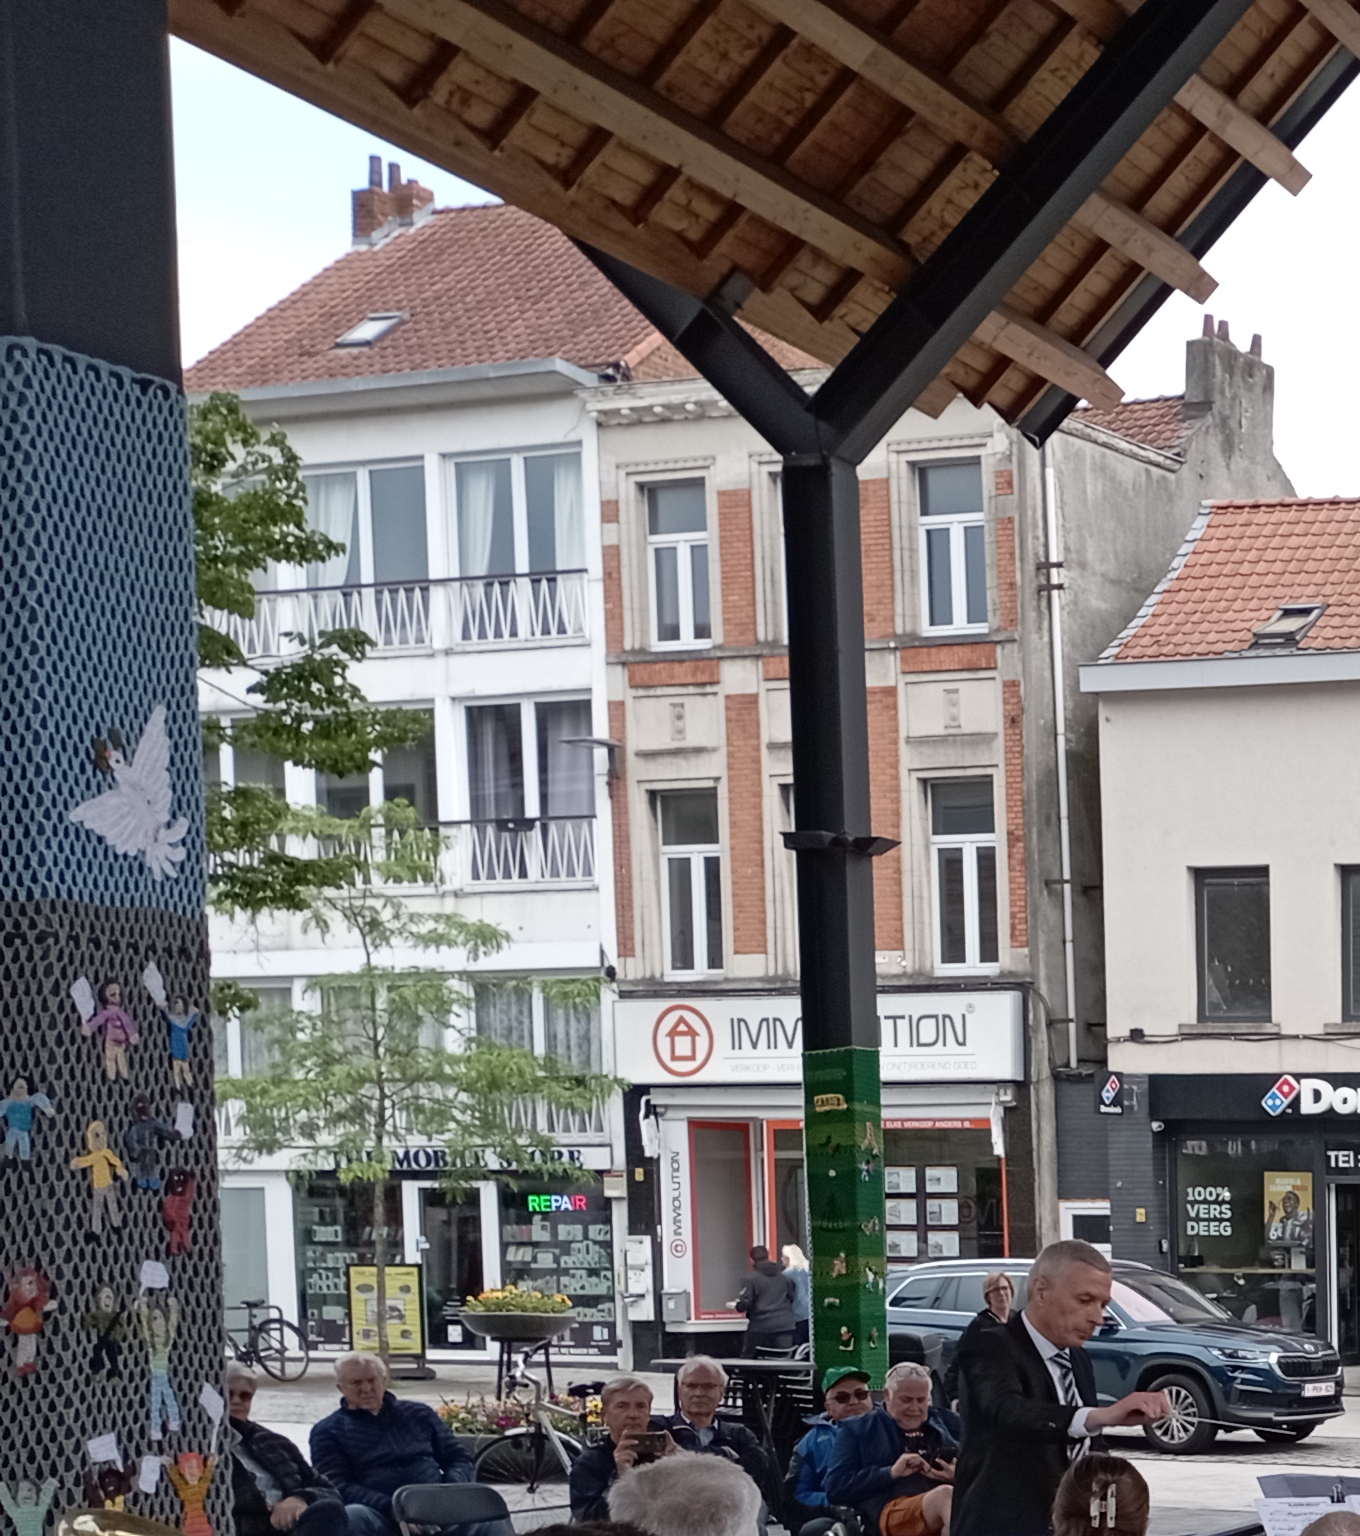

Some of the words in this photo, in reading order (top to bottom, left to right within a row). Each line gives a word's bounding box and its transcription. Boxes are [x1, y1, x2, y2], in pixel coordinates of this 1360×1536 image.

[730, 1013, 967, 1050] IMMTION
[670, 1151, 682, 1236] IMMOLUTION
[1186, 1186, 1231, 1201] 100%
[527, 1194, 587, 1212] REPAIR
[1186, 1203, 1232, 1218] VERS
[1186, 1221, 1232, 1236] DEEG
